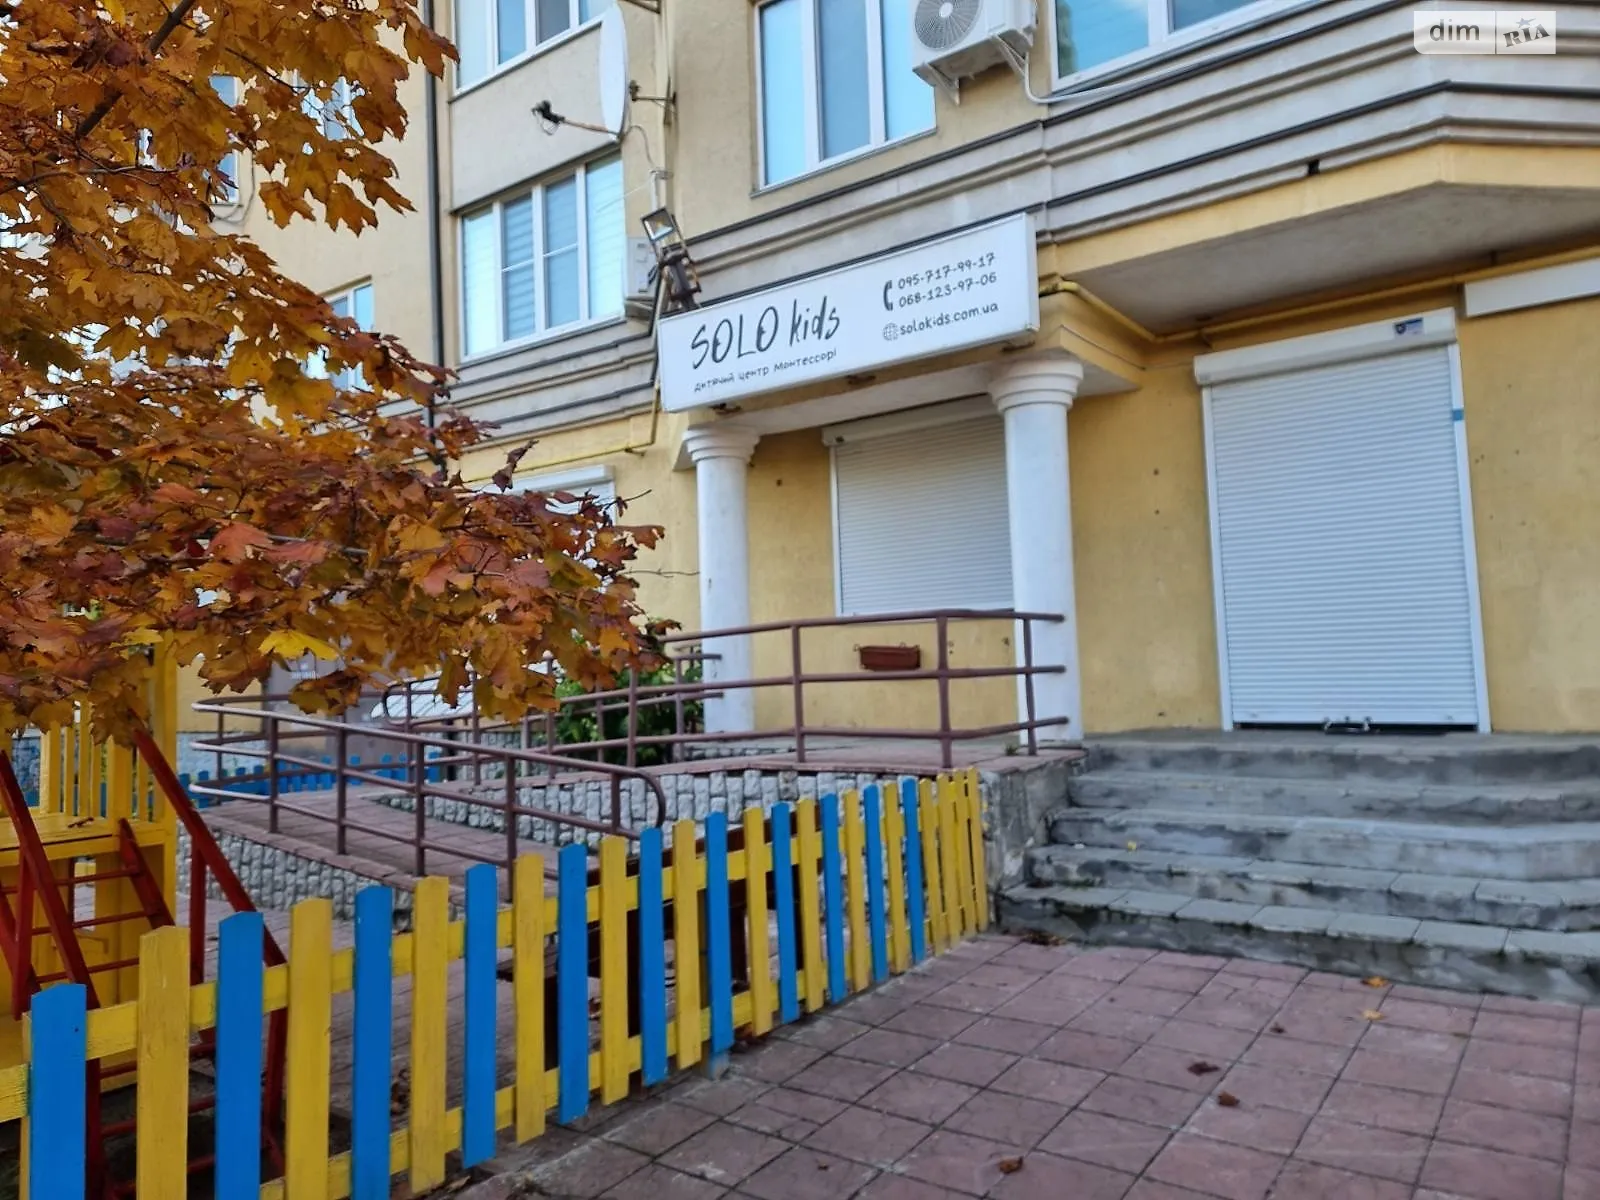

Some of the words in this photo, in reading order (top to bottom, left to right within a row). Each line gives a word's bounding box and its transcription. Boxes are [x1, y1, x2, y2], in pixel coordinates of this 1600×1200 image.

[898, 252, 995, 290] 095-717-99-17
[899, 271, 997, 308] 068-123-97-06
[691, 306, 779, 370] SOLO
[789, 295, 840, 347] kids
[900, 302, 999, 336] solokids.com.ua
